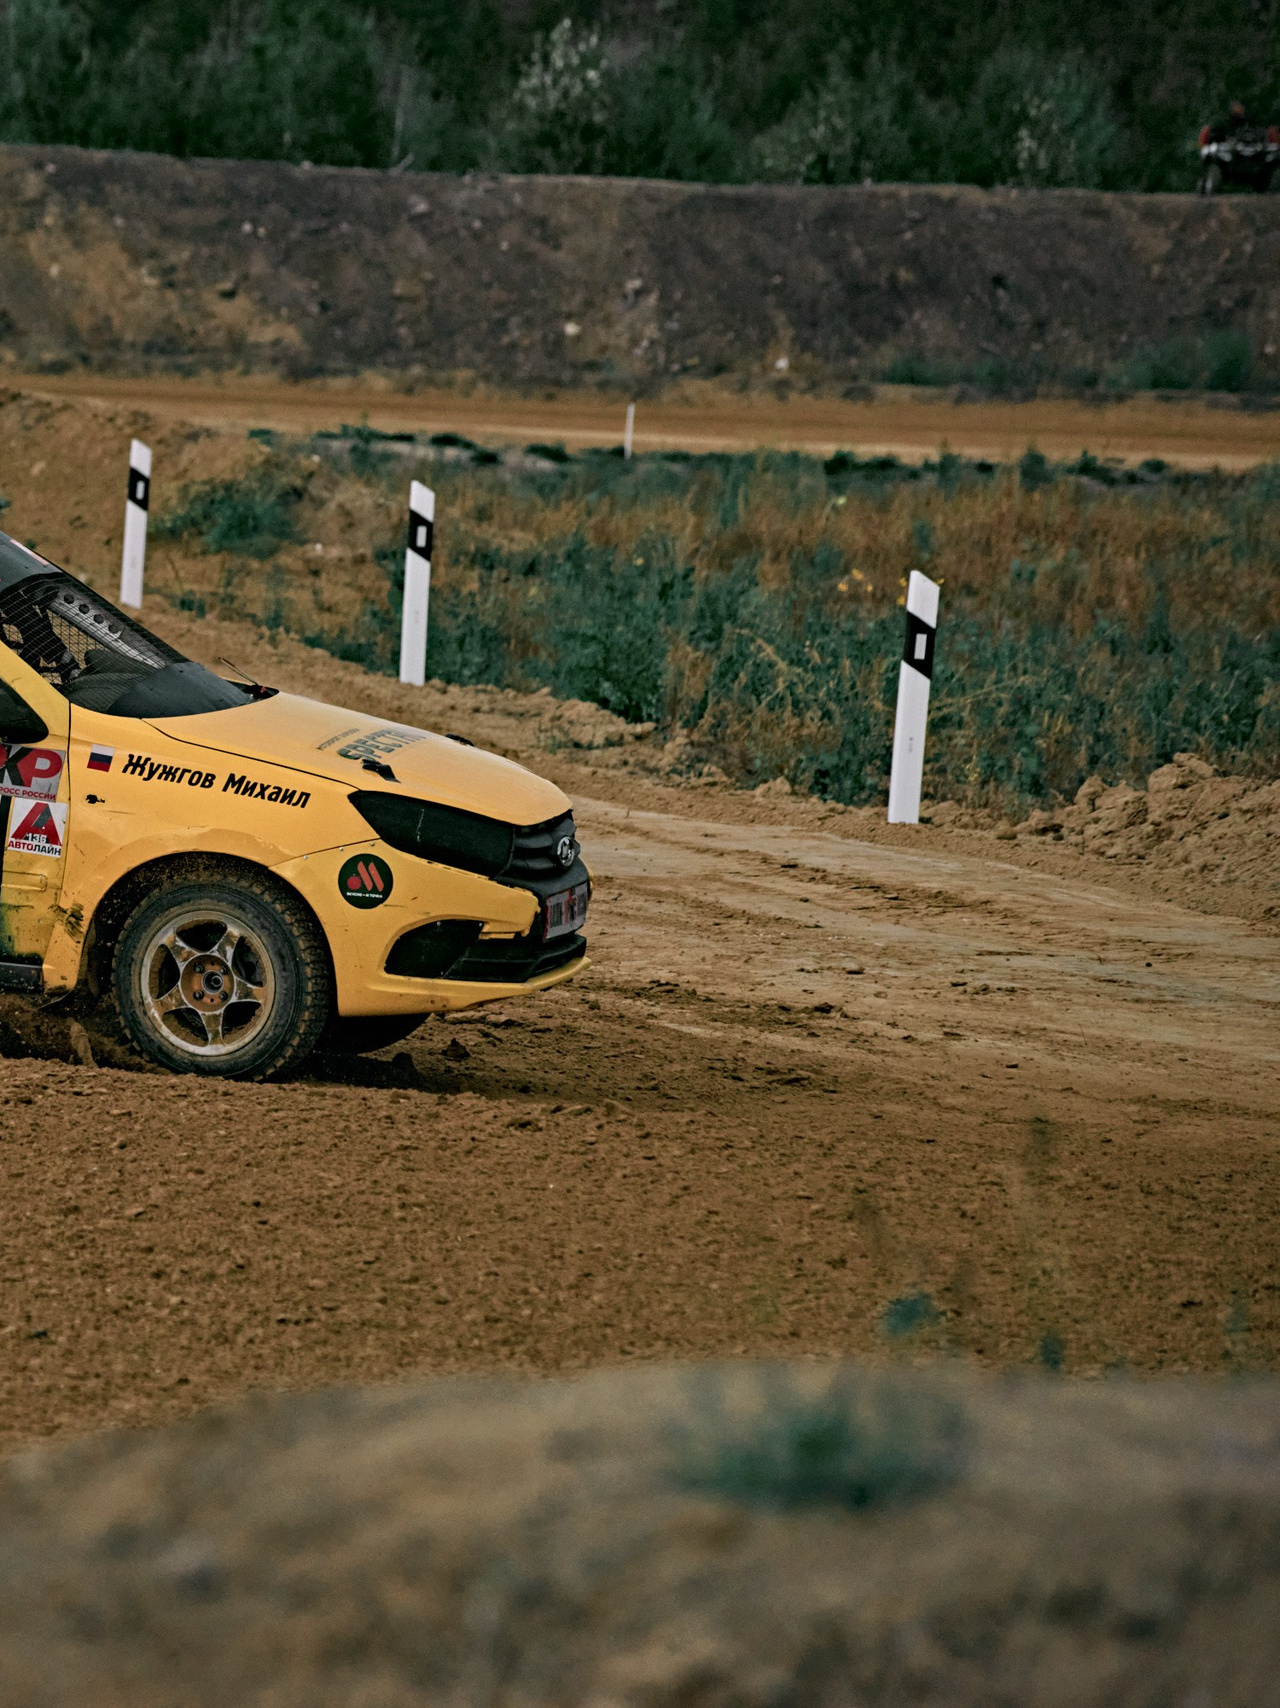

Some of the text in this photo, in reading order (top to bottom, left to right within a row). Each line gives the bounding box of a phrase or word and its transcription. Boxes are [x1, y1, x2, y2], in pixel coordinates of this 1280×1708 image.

[122, 753, 312, 809] Жужгов Михаил
[21, 788, 57, 801] РОССИИ
[26, 832, 48, 844] 136
[7, 840, 62, 857] АВТОЛАЙН
